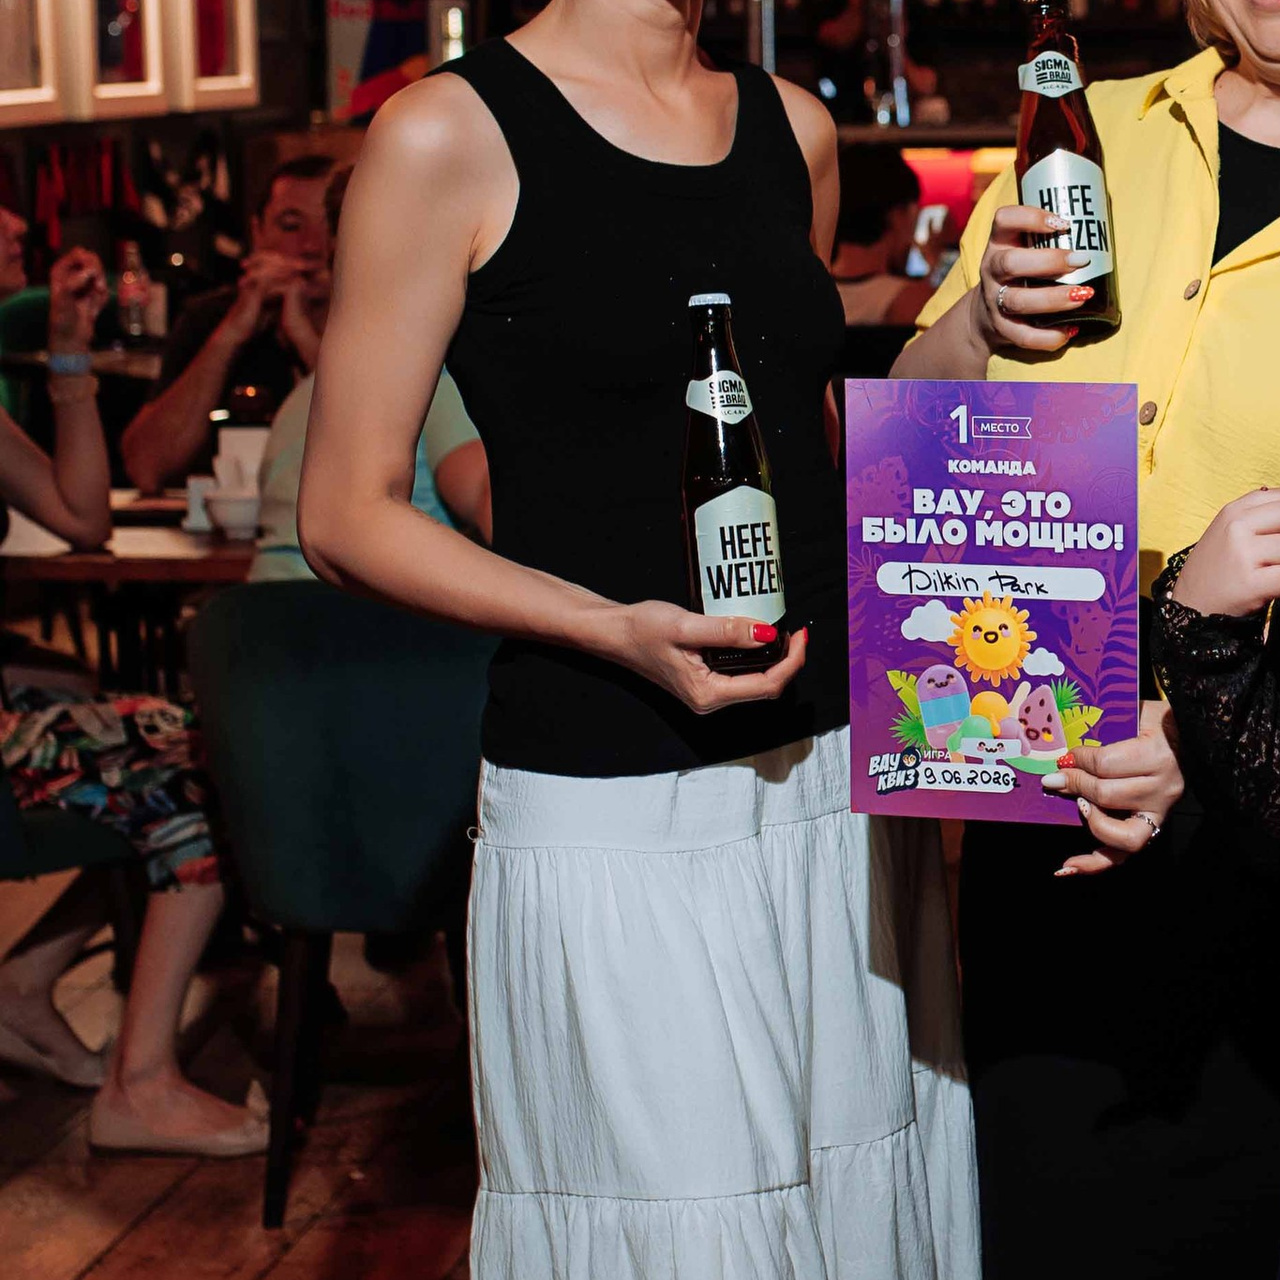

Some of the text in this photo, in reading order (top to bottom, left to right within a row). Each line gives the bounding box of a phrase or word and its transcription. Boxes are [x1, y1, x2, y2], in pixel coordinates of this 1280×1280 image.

[1035, 58, 1070, 73] SIGMA
[949, 405, 1020, 444] 1 МЕСТО
[947, 459, 1037, 476] КОМАНДА
[912, 488, 1072, 521] ВАУ, ЭТО
[719, 521, 774, 561] HEFE
[862, 517, 1125, 554] БЫЛО МОЩНО!
[705, 558, 785, 601] WEIZEN
[988, 570, 1049, 595] Park
[868, 752, 901, 776] ВАУ
[923, 750, 951, 759] ИГРА
[876, 767, 916, 791] КВИЗ
